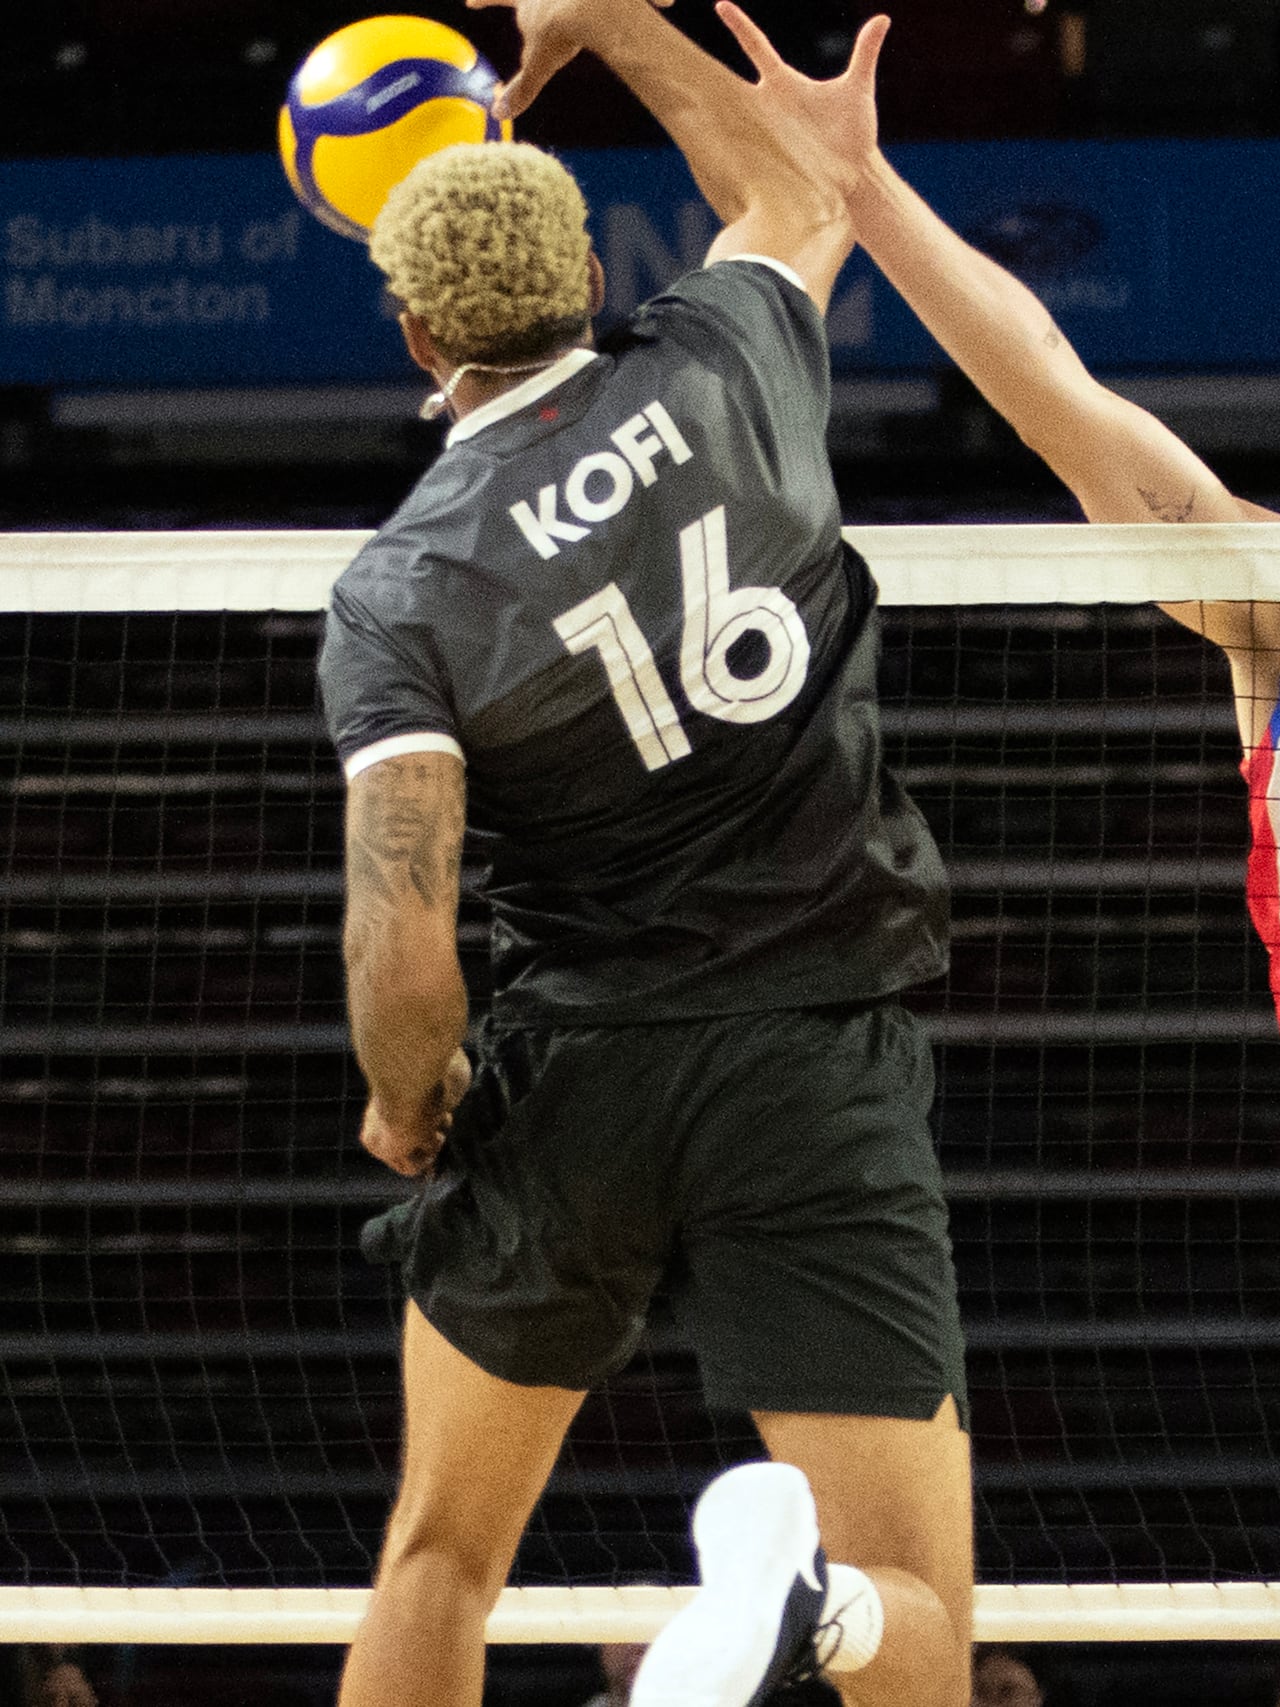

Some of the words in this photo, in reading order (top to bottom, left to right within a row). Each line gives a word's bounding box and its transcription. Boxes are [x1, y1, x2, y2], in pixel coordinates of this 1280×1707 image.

[5, 214, 222, 266] Subaru
[240, 208, 299, 262] of
[6, 273, 269, 326] Moncton
[510, 400, 694, 560] KOFI
[552, 505, 810, 772] 16
